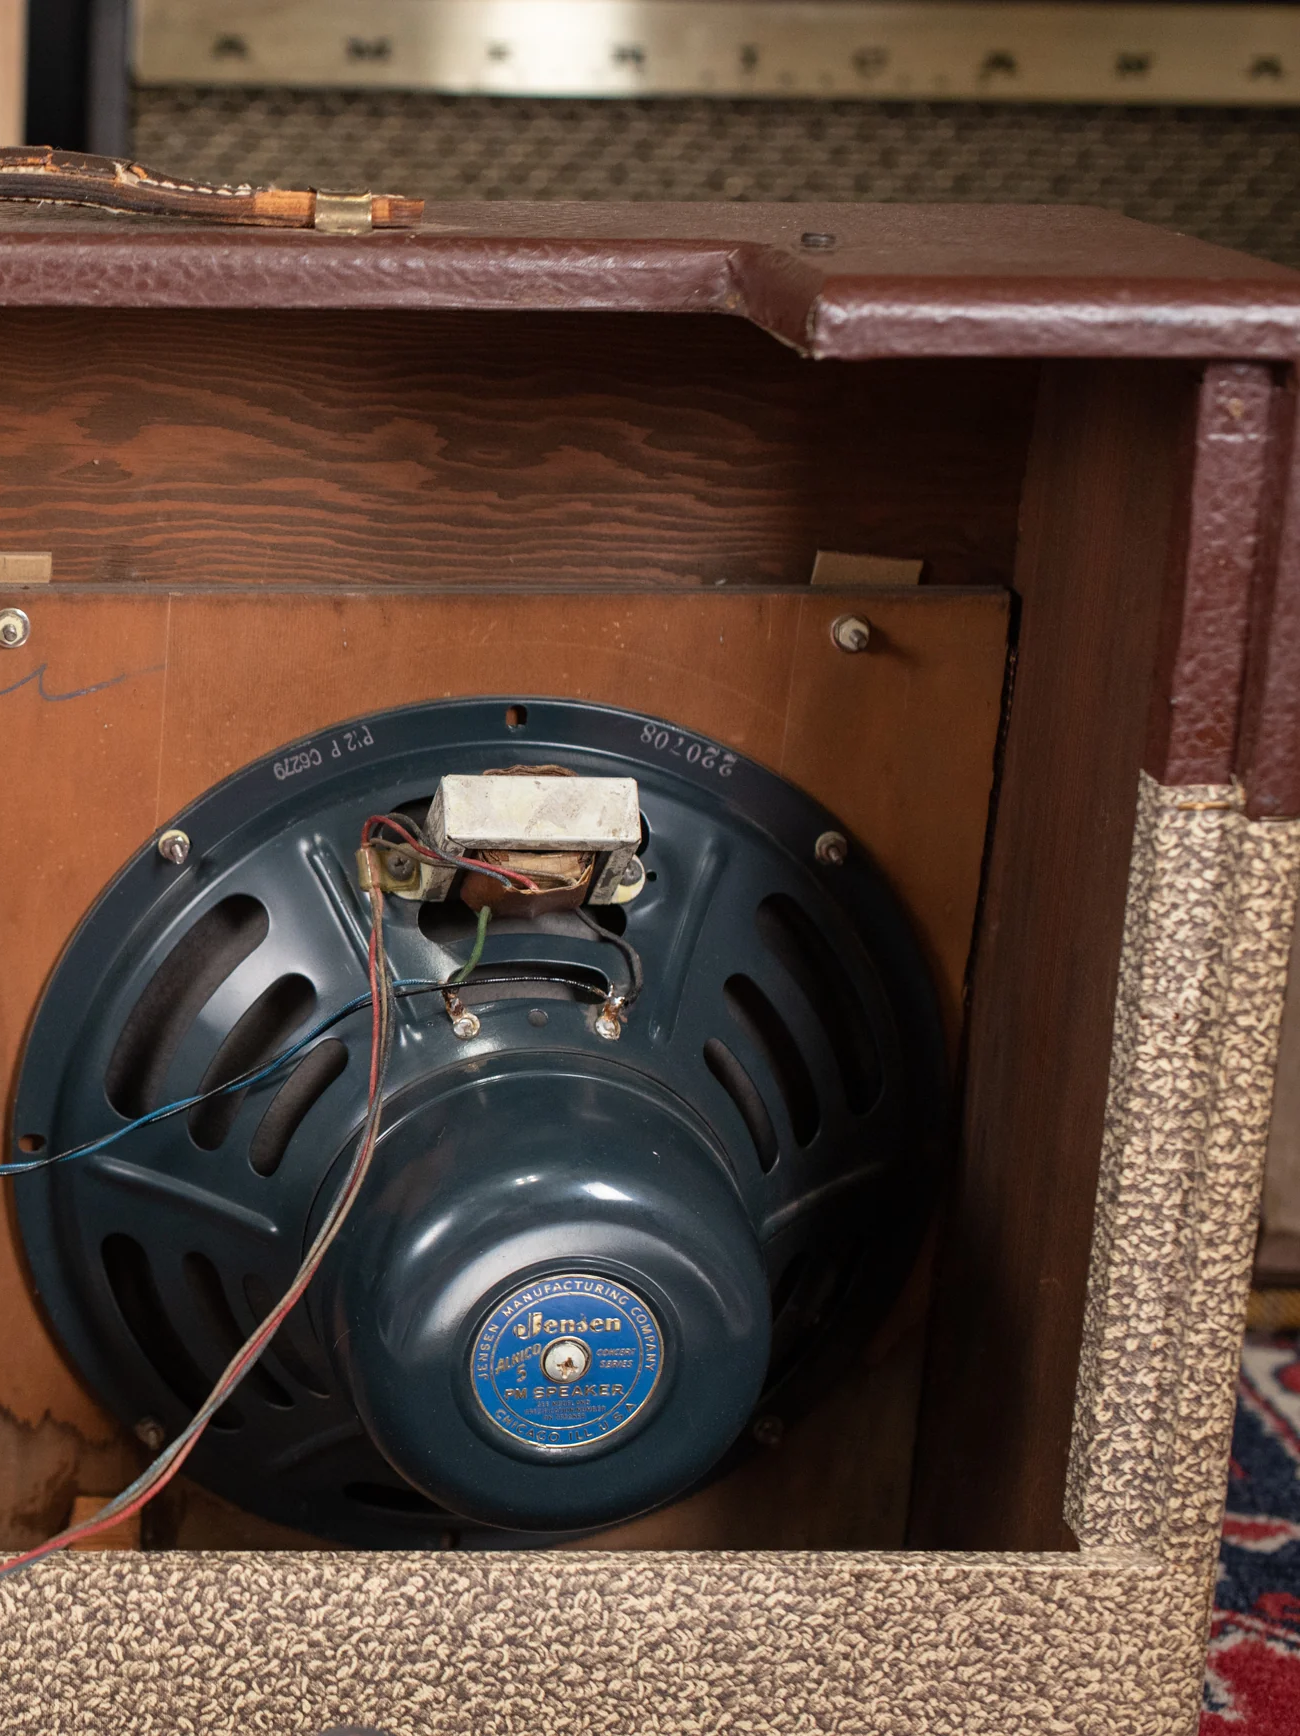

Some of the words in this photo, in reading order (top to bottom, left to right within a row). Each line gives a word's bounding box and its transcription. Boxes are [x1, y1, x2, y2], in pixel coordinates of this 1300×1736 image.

[640, 723, 737, 777] 220708
[273, 748, 322, 781] C6279
[478, 1323, 499, 1380] JENSEN
[501, 1280, 630, 1317] MANUFACTURING
[630, 1306, 657, 1372] COMPANY
[513, 1312, 622, 1340] Jensen
[495, 1343, 542, 1375] ALNICO
[596, 1347, 637, 1357] CONCERT
[599, 1359, 634, 1368] SERIES
[516, 1364, 527, 1383] 5
[504, 1387, 528, 1400] PM
[533, 1384, 625, 1400] SPEAKER
